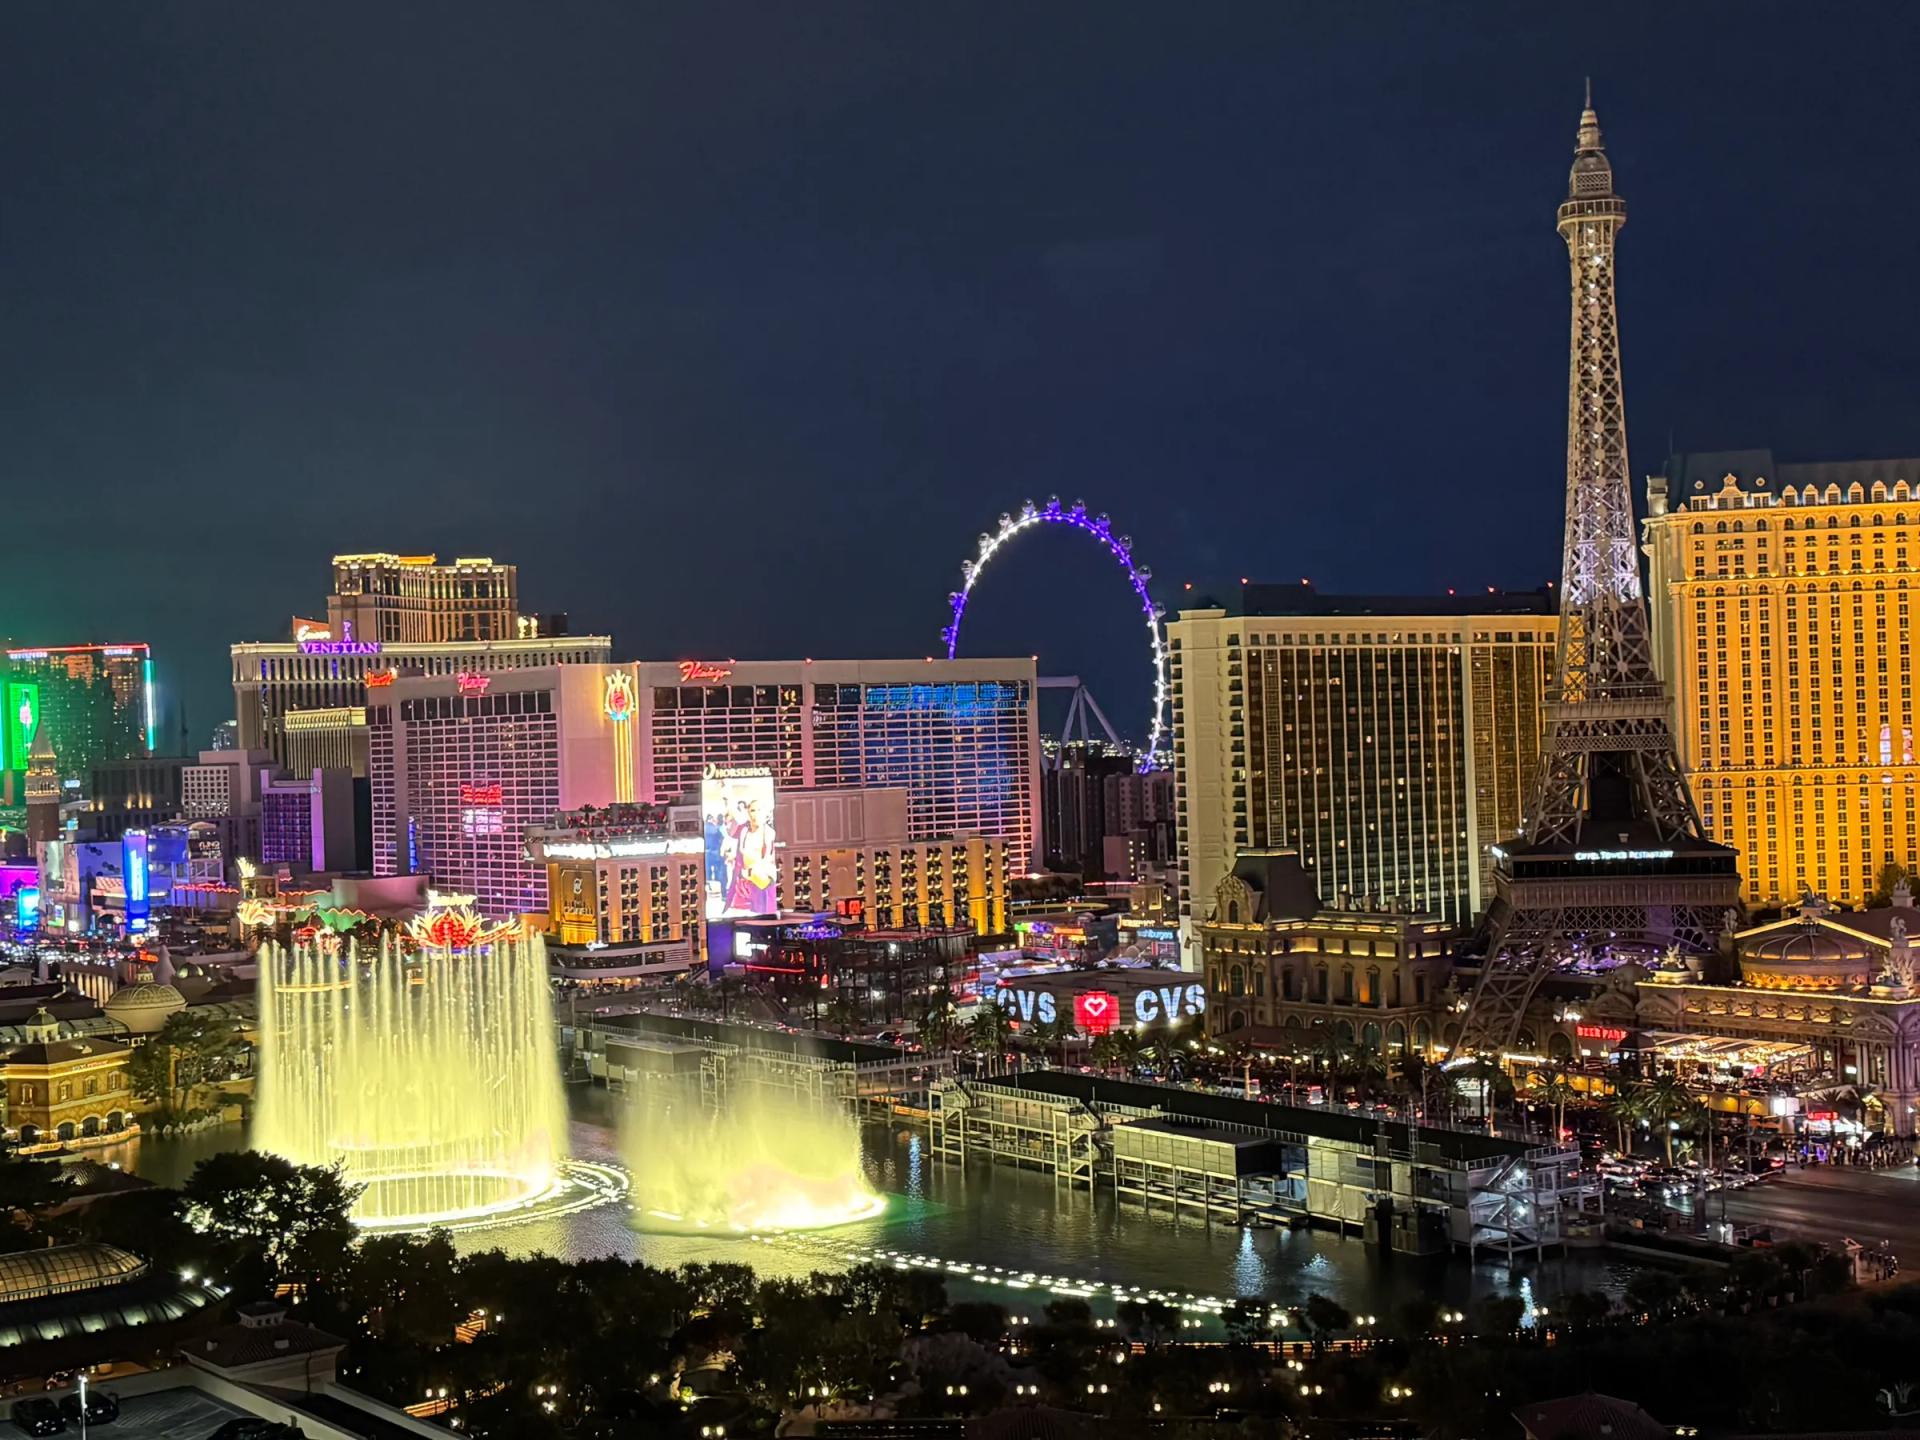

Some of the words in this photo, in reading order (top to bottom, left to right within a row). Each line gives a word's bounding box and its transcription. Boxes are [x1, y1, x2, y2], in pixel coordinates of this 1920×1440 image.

[300, 642, 379, 653] VENETIAN
[998, 987, 1057, 1024] CVS
[1135, 984, 1206, 1022] CVS
[1577, 1026, 1601, 1038] BEER
